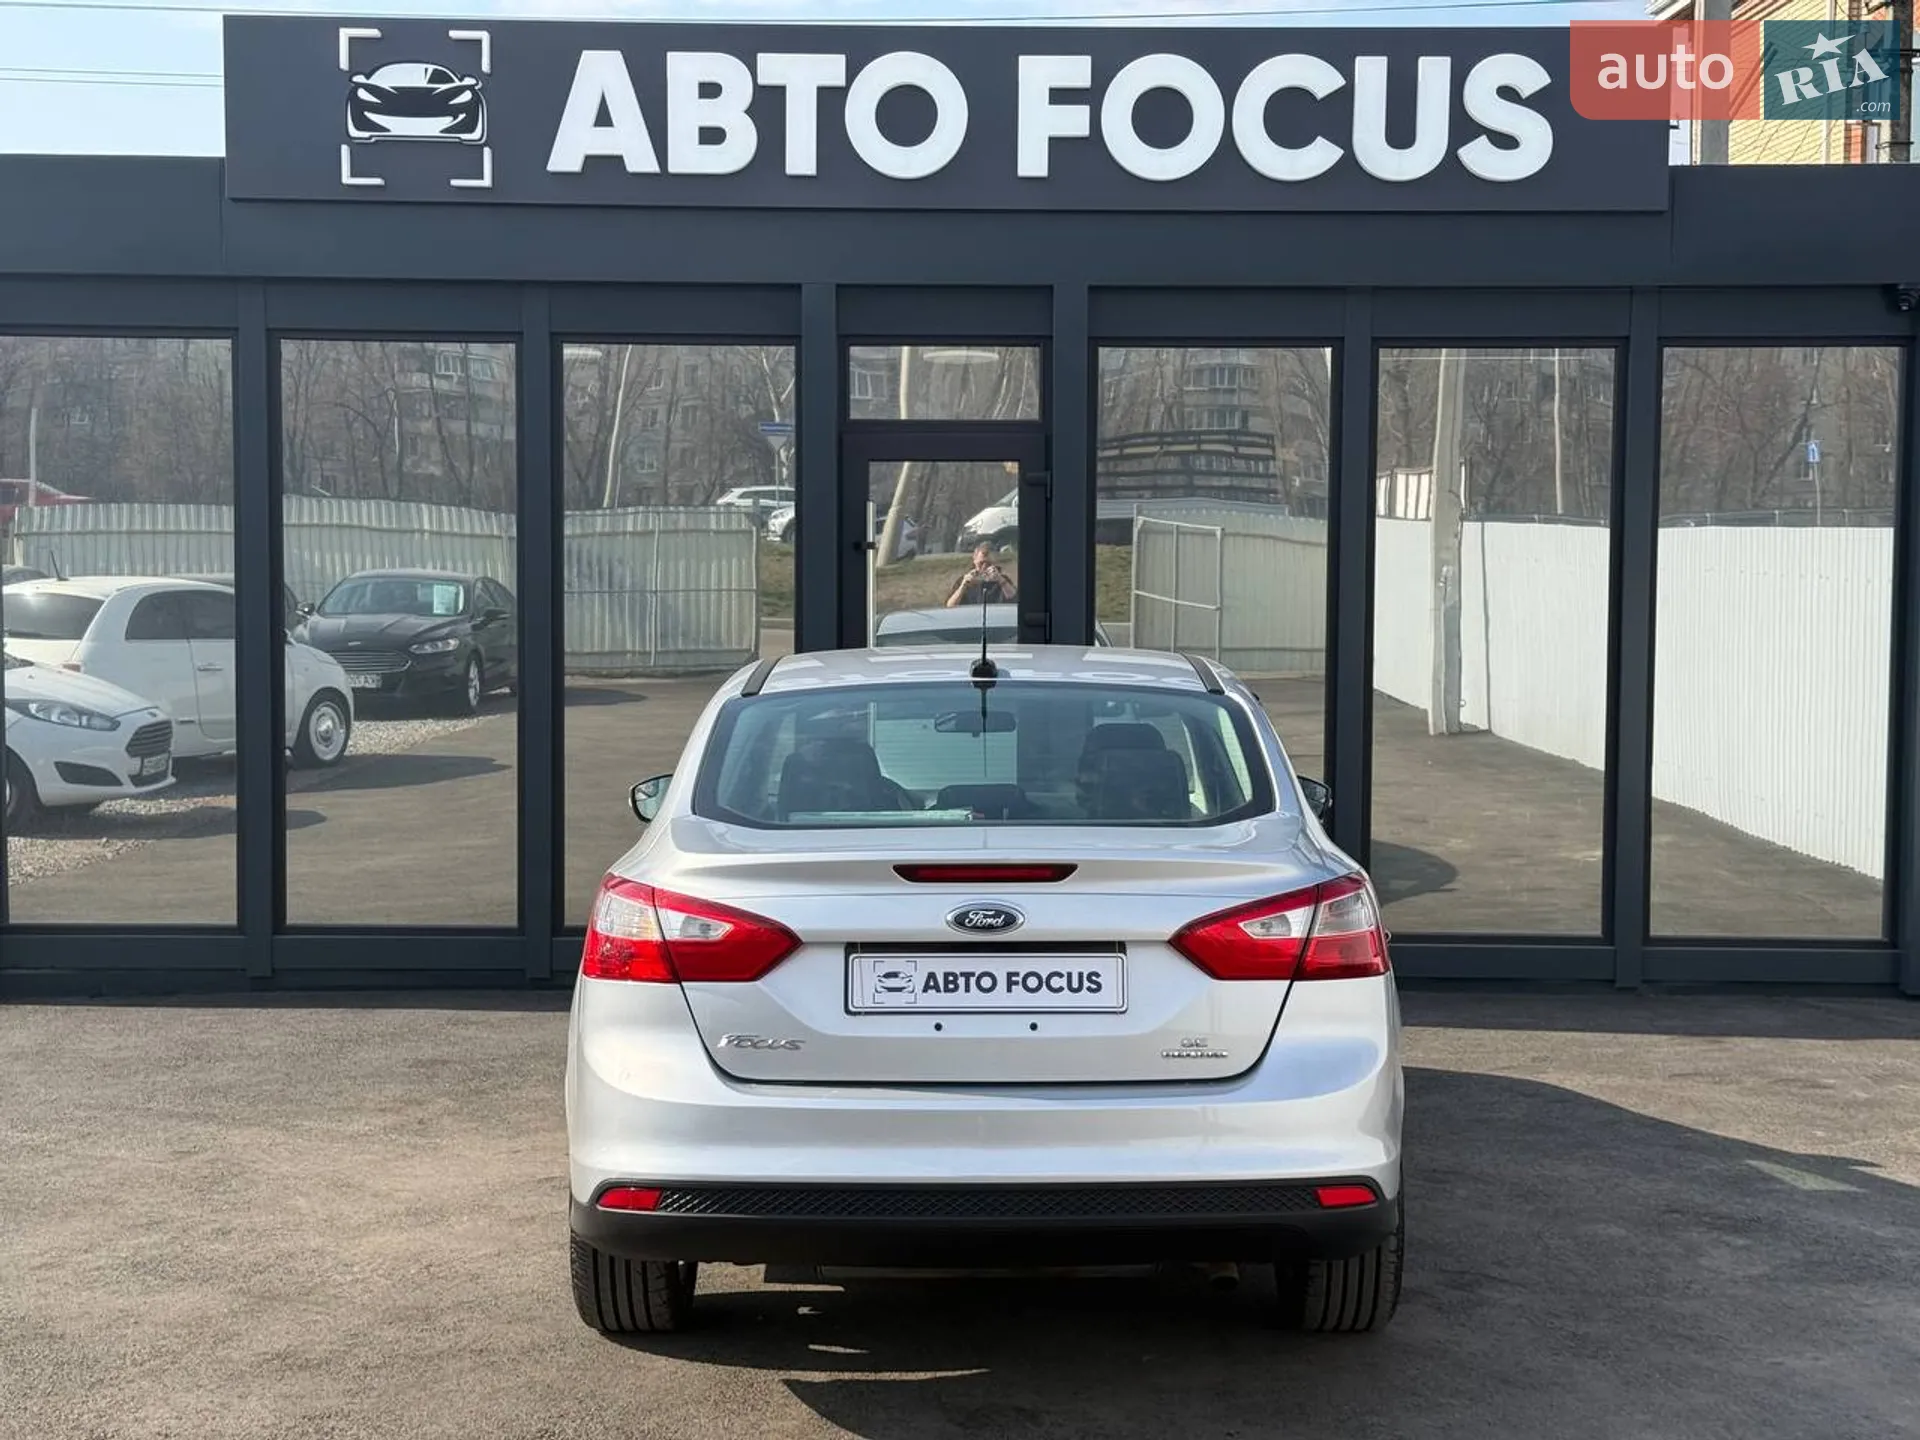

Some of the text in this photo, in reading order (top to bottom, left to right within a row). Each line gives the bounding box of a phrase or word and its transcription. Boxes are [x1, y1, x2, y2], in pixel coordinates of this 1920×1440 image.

[546, 50, 1554, 182] АВТО FOCUS
[965, 910, 1005, 927] Ford
[922, 970, 1102, 994] АВТО FOCUS
